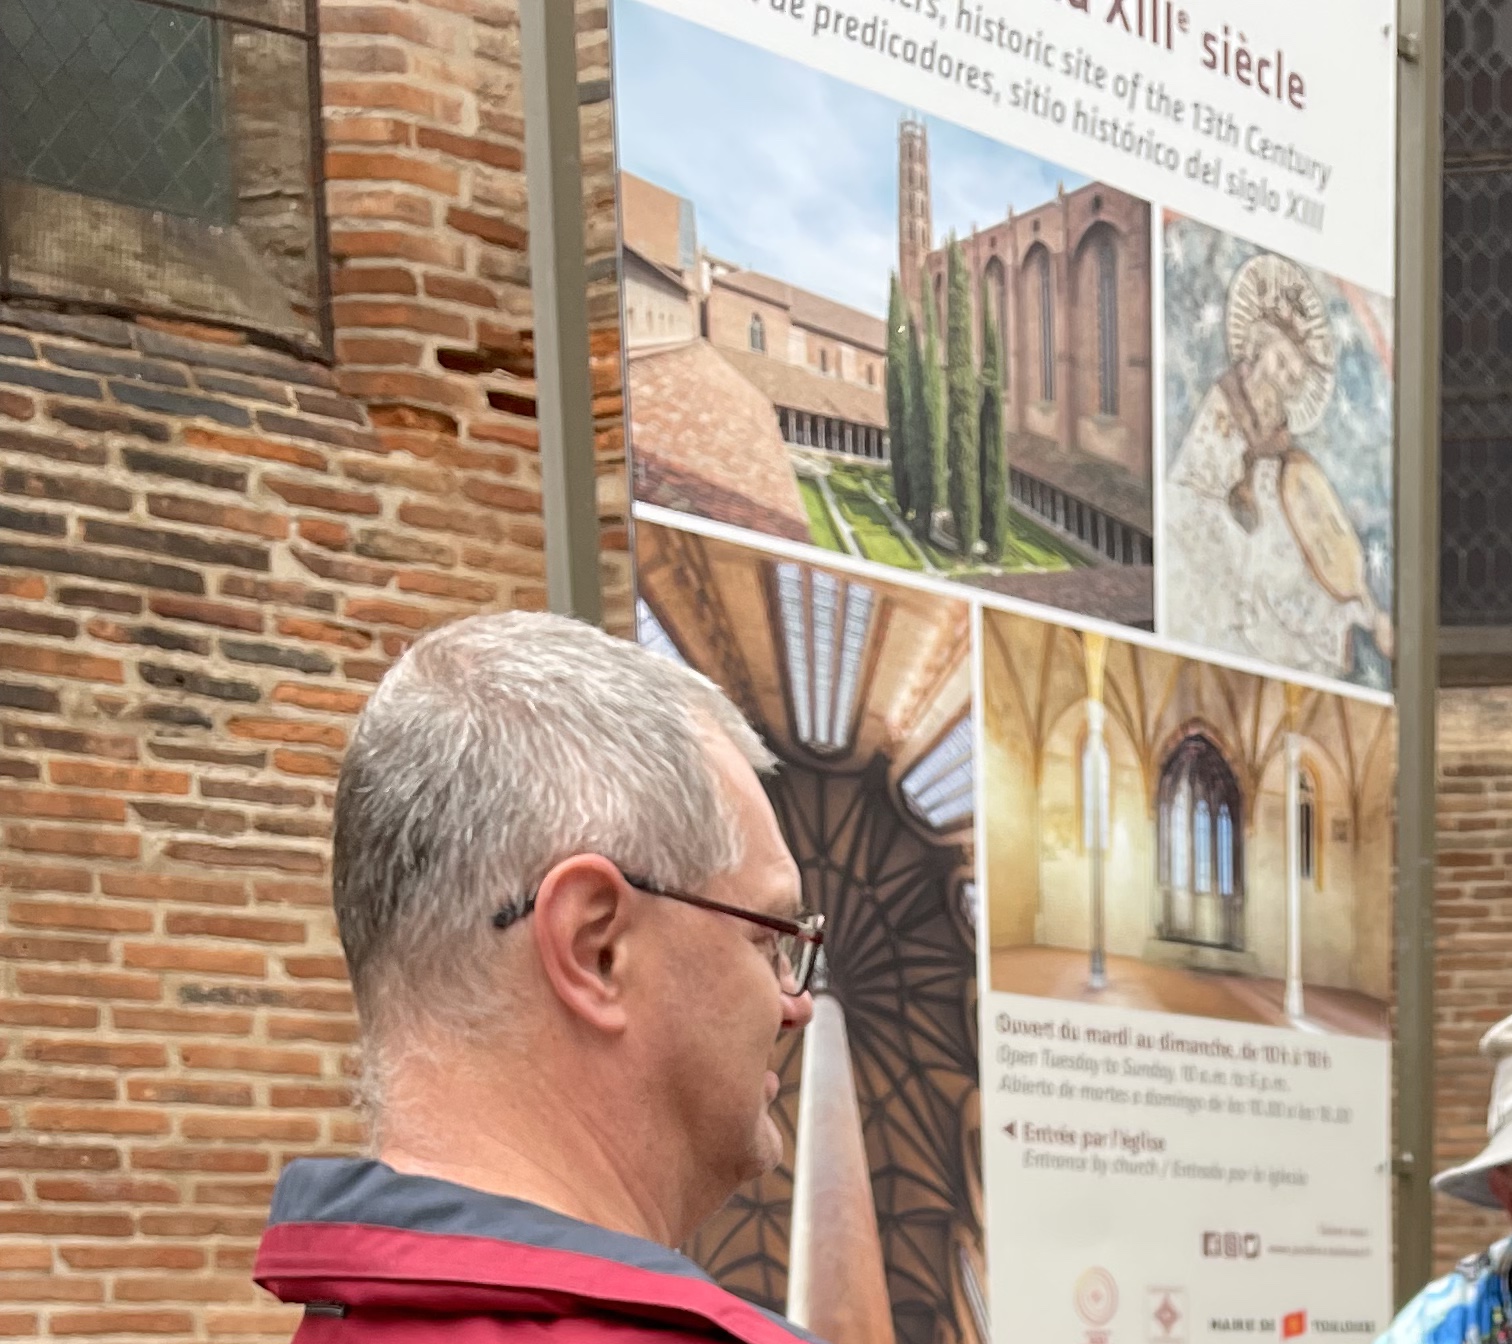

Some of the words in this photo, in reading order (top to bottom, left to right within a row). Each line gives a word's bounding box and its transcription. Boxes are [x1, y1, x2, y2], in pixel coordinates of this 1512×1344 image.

[955, 3, 1055, 68] historic
[1061, 47, 1107, 89] site
[1112, 72, 1143, 111] of
[1146, 81, 1185, 122] the
[1191, 102, 1239, 147] 13th
[1245, 125, 1332, 191] Century
[1202, 25, 1305, 110] siècle
[813, 4, 1001, 103] predicadores,
[1009, 77, 1066, 124] sitio
[1072, 98, 1179, 171] histórico
[1185, 148, 1222, 189] del
[1225, 167, 1280, 213] siglo
[1285, 189, 1325, 232] XIII
[997, 1012, 1054, 1038] Ouvert
[1060, 1020, 1080, 1040] du
[1086, 1026, 1131, 1045] mardi
[1137, 1033, 1153, 1049] au
[997, 1045, 1037, 1068] Open
[1042, 1049, 1099, 1075] Tuesday
